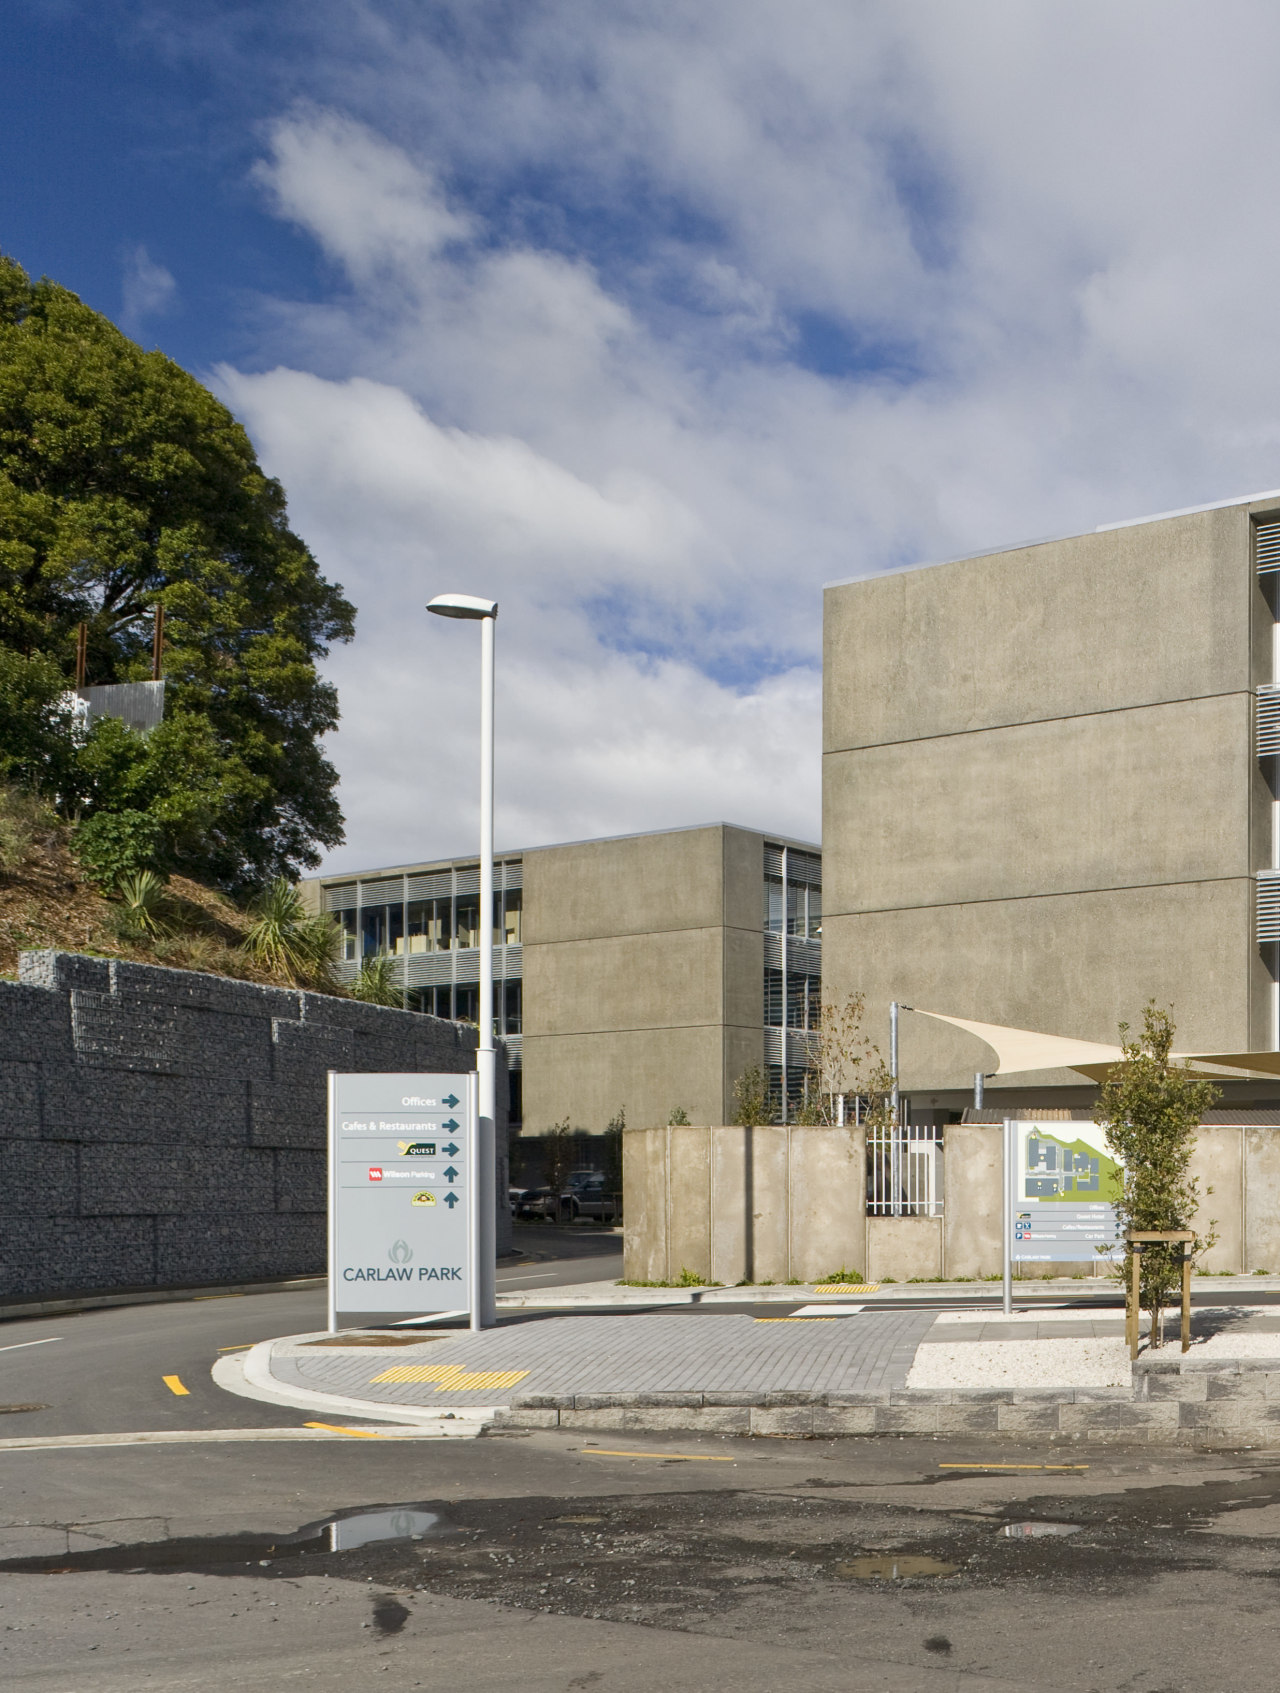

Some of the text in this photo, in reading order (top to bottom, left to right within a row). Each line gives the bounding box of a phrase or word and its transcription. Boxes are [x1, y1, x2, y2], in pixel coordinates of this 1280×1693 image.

[401, 1097, 437, 1106] Offices
[342, 1121, 437, 1131] Cafes & Restaurants
[343, 1267, 463, 1281] CARLAW PARK
